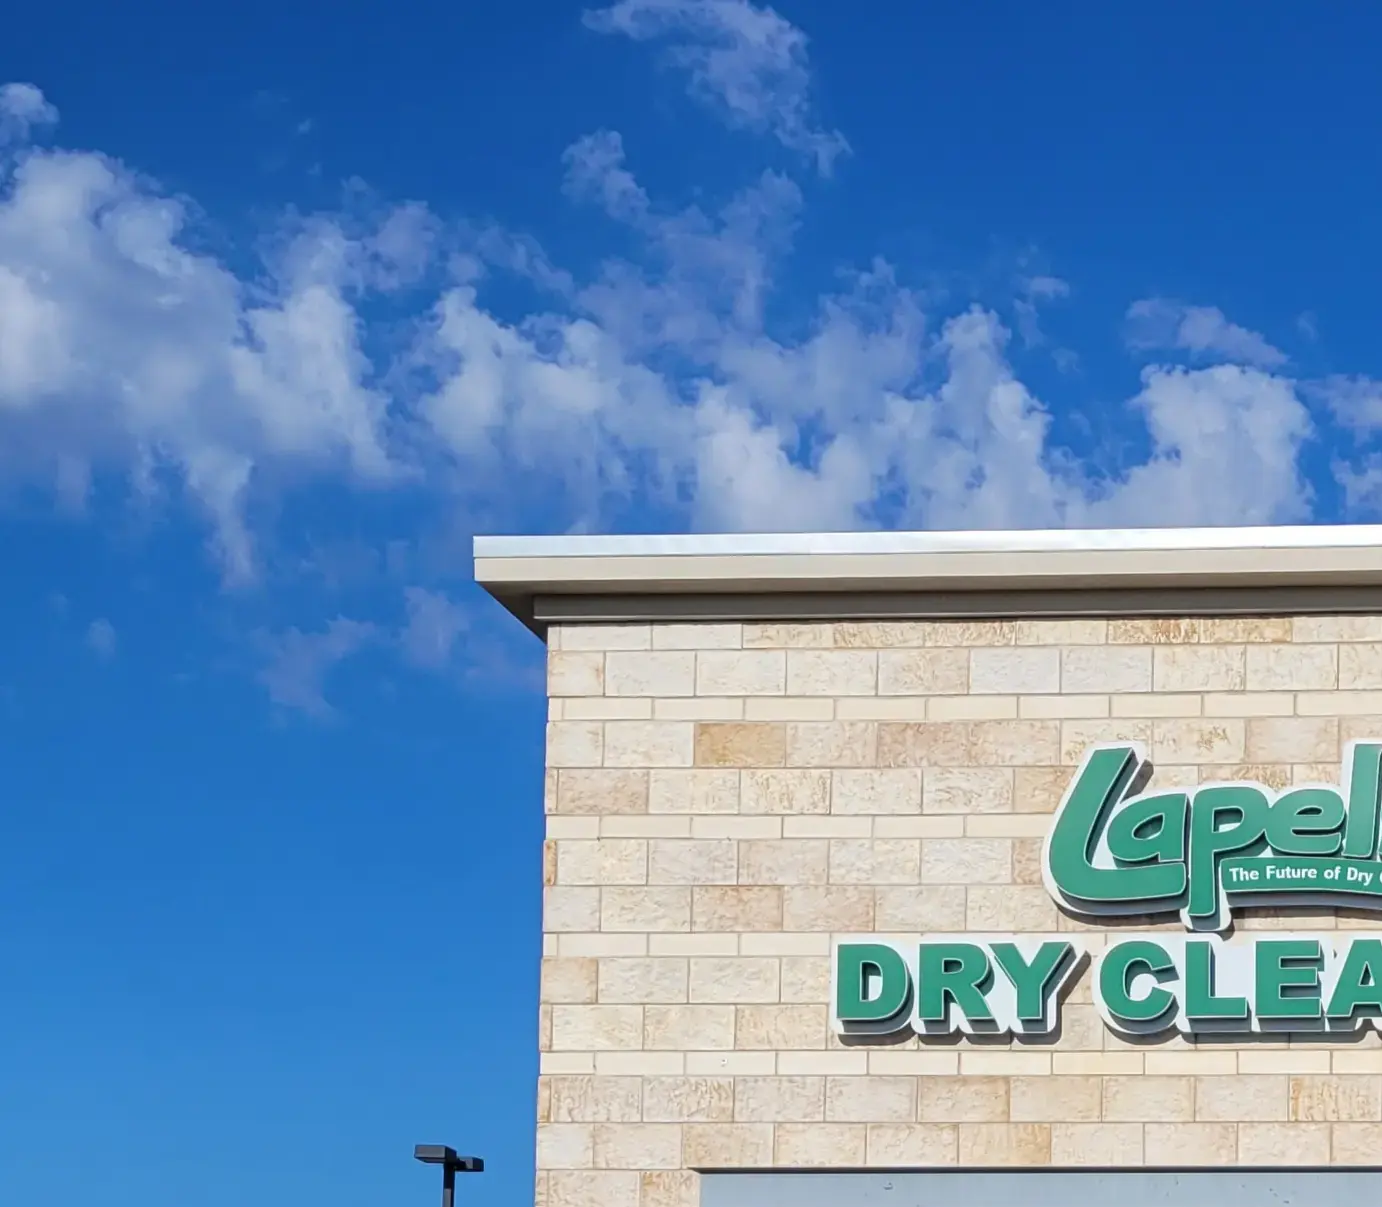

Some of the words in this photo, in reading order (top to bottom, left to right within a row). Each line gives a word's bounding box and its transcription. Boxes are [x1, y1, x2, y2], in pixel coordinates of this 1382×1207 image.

[1229, 866, 1259, 882] The
[1266, 865, 1317, 881] Future
[1324, 866, 1340, 881] of
[1347, 867, 1373, 886] Dry
[836, 941, 1070, 1022] DRY
